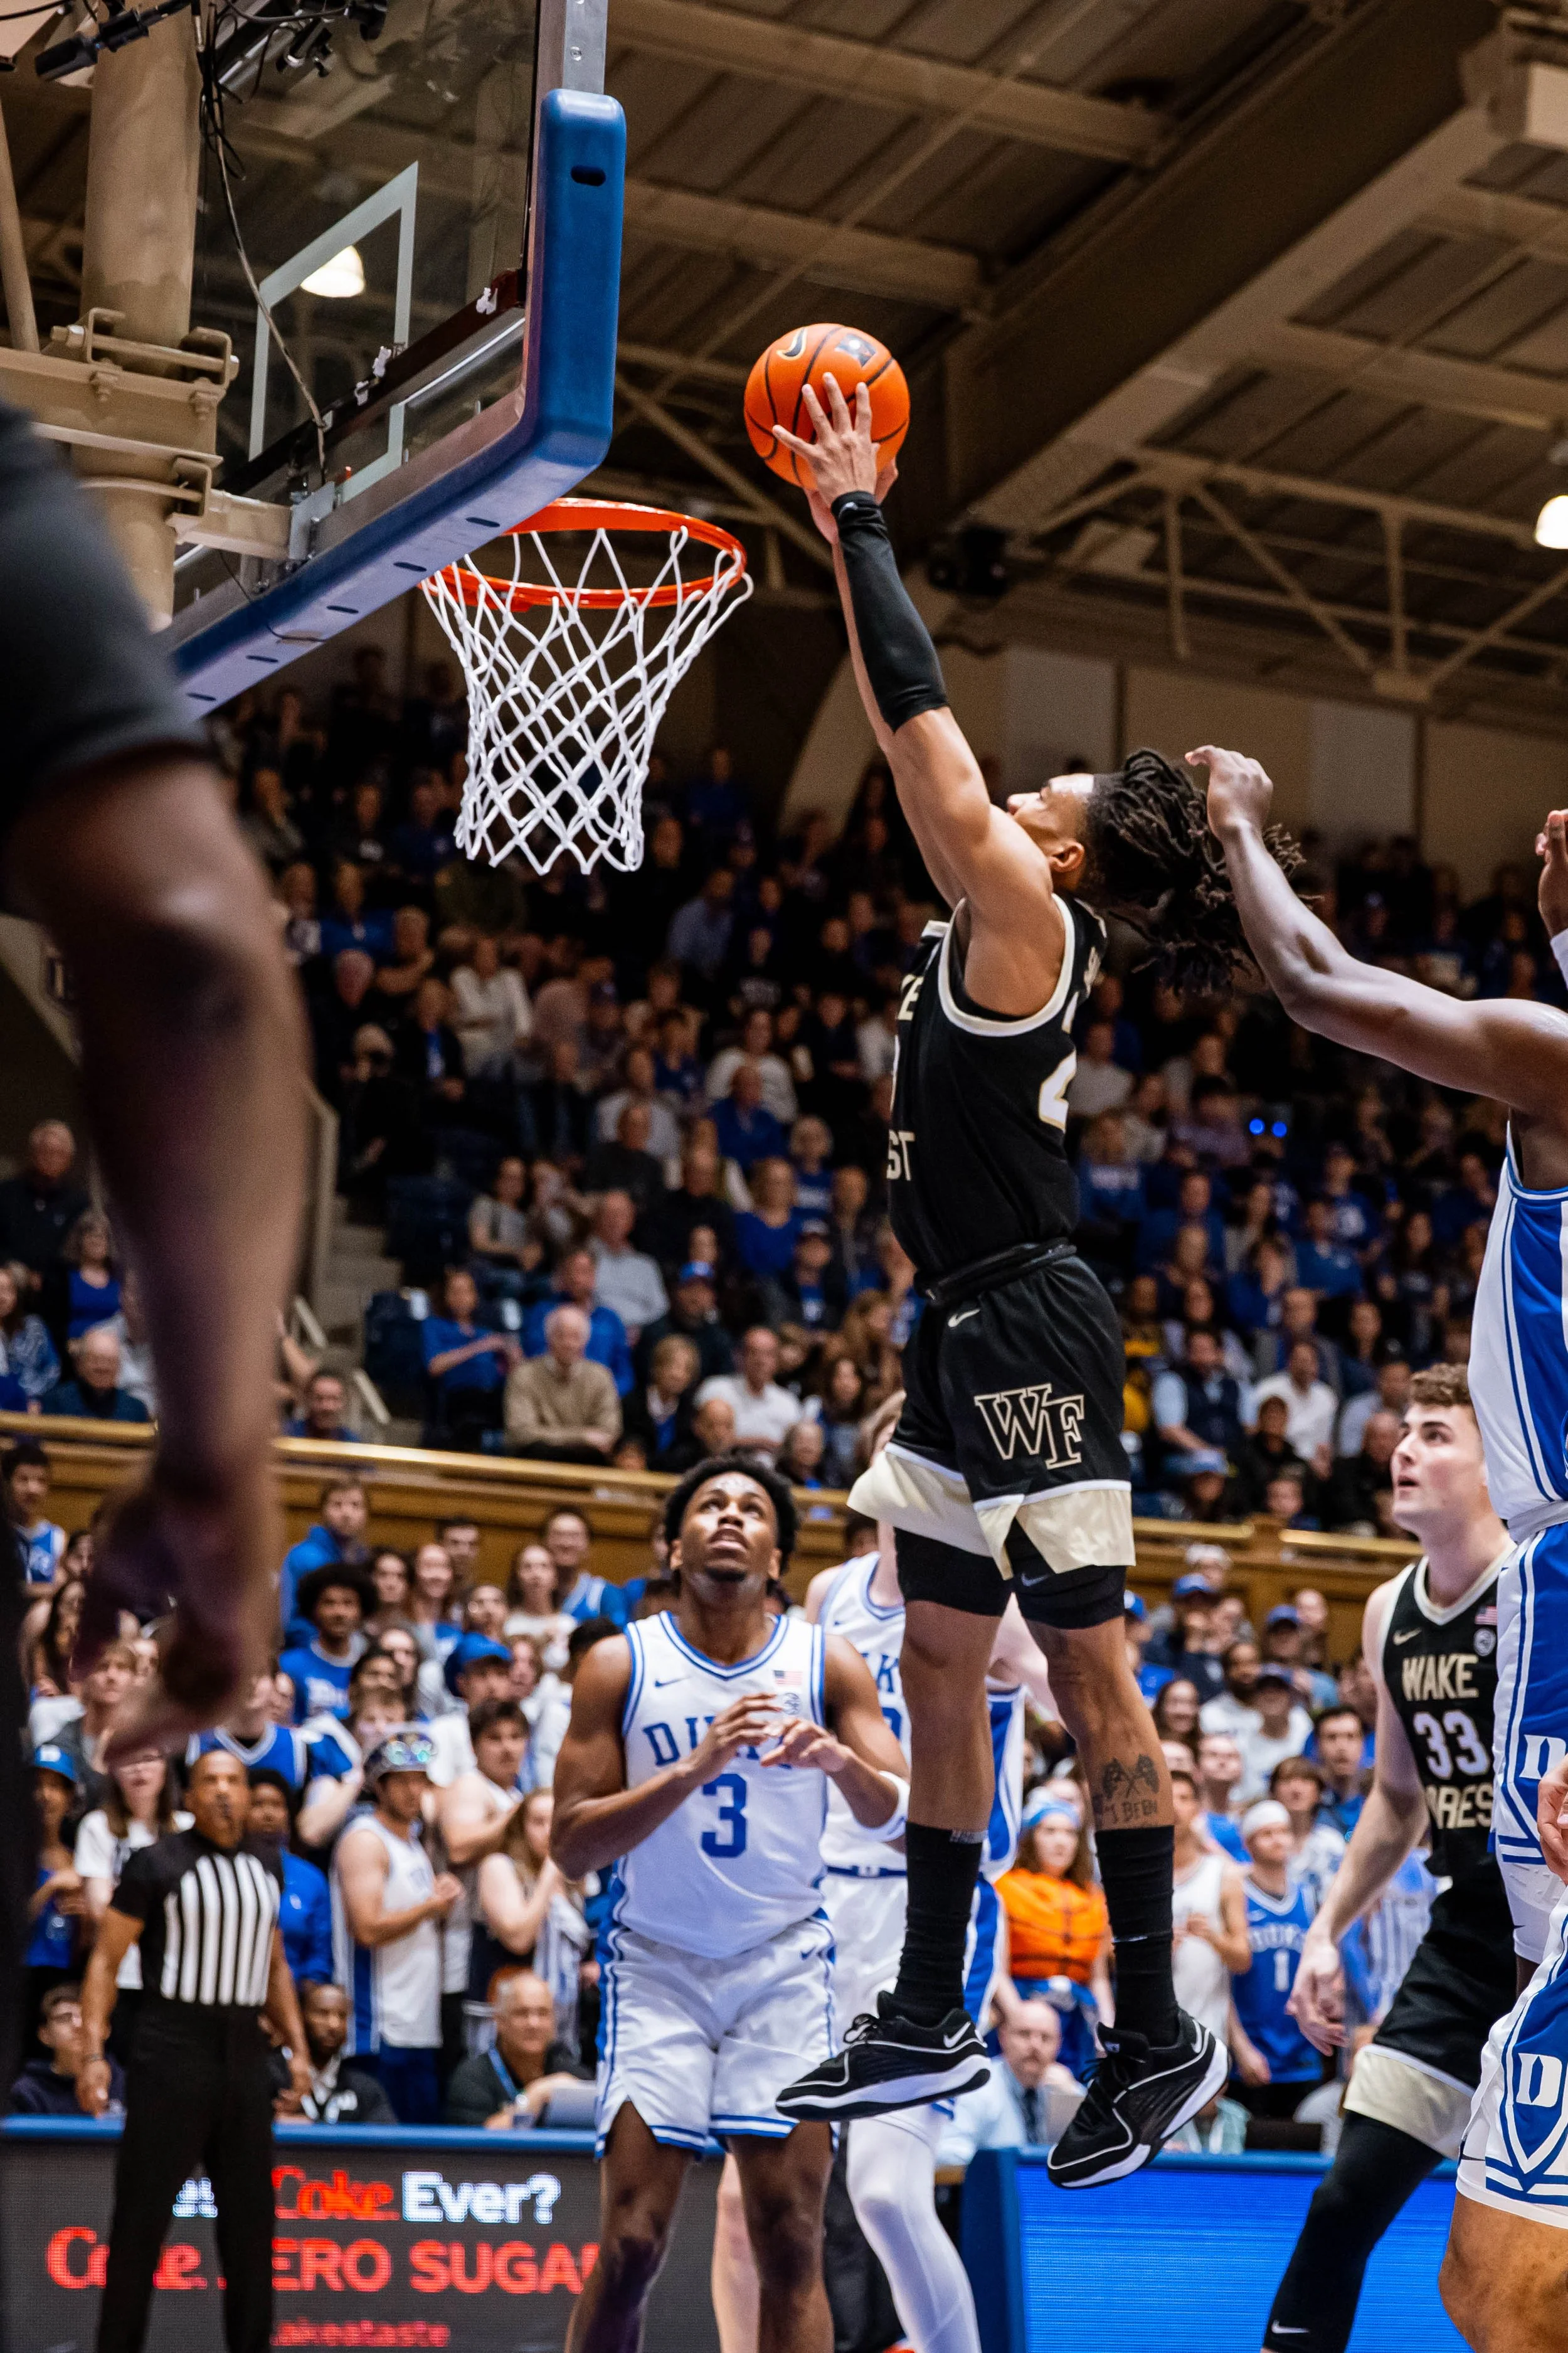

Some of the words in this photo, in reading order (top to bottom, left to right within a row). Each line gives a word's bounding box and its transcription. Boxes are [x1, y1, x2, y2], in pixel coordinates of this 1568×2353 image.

[974, 1383, 1084, 1469] WF
[1402, 1652, 1479, 1701] WAKE
[1413, 1709, 1490, 1780] 33
[701, 1773, 747, 1858] 3
[1516, 2053, 1562, 2108] D
[402, 2171, 561, 2224] Ever?
